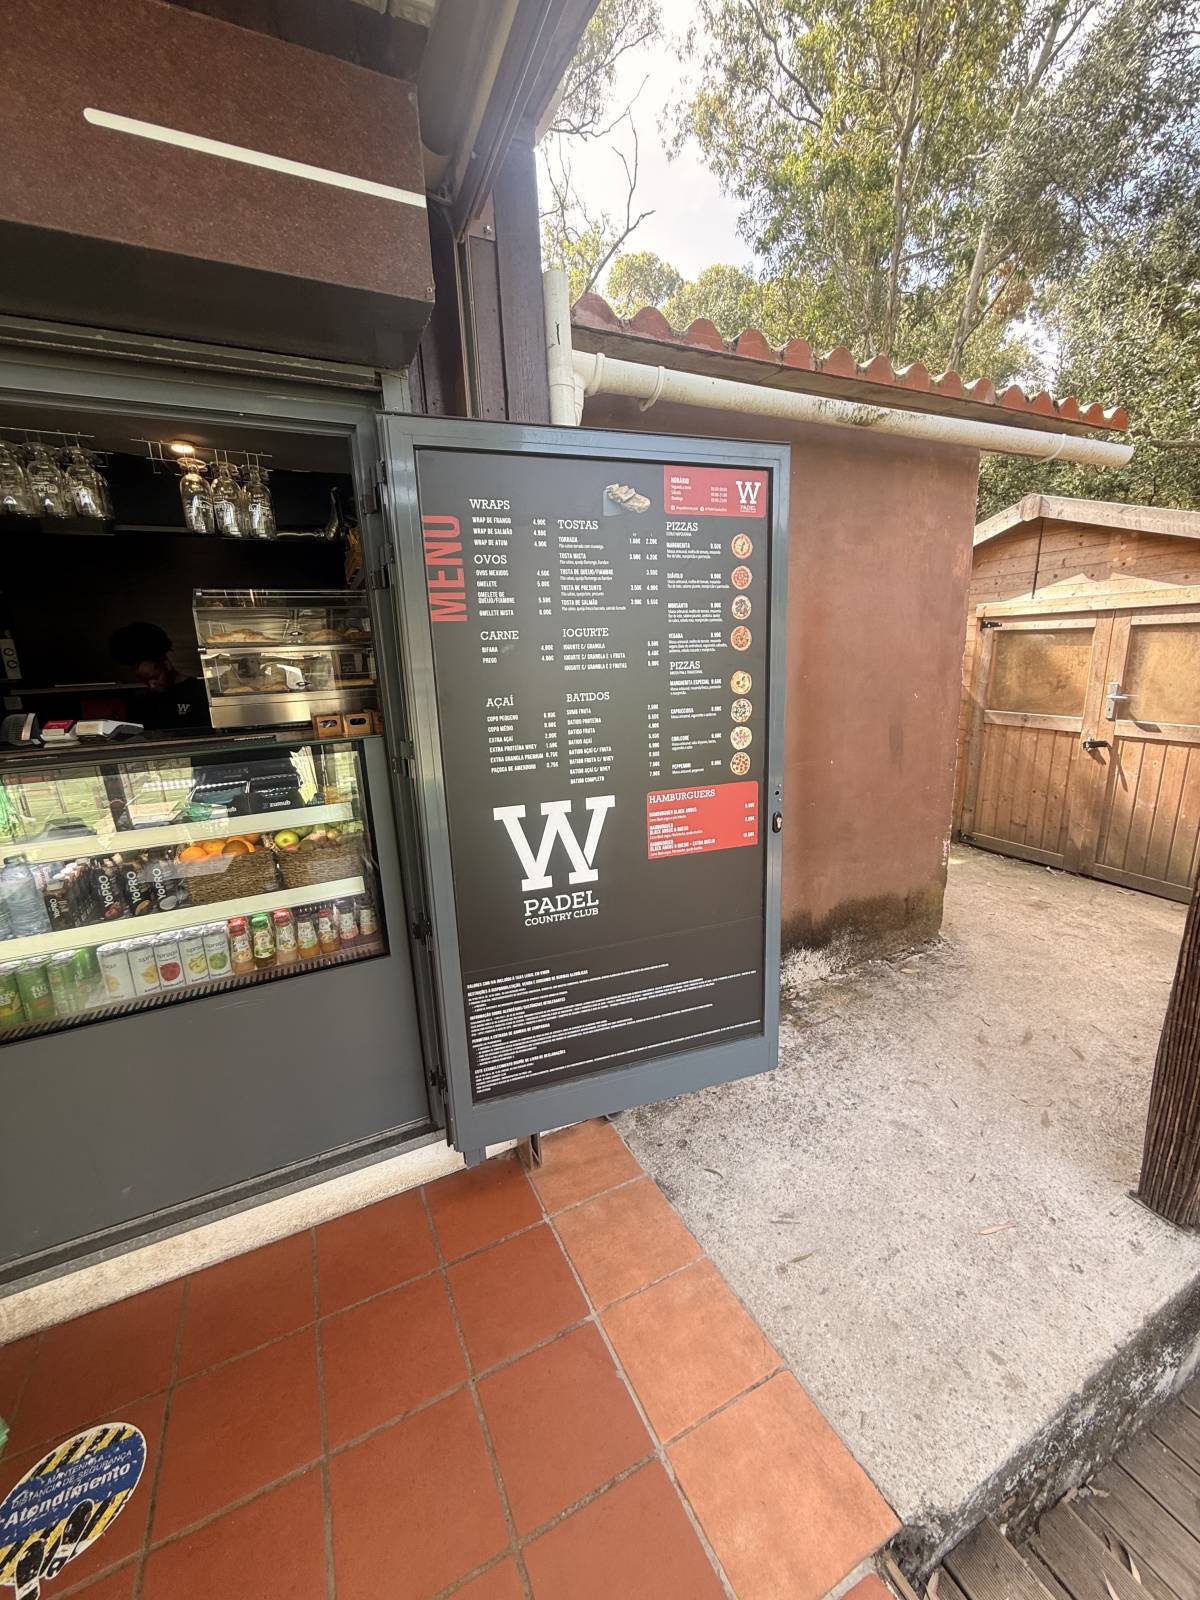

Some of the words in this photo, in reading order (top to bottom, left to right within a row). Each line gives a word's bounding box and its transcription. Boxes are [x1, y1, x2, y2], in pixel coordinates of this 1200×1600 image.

[736, 481, 761, 504] W
[469, 499, 510, 510] WRAPS
[558, 520, 598, 530] TOSTAS
[666, 522, 698, 531] PIZZAS
[474, 555, 507, 564] OVOS
[422, 515, 468, 621] MENU
[480, 631, 519, 640] CARNE
[563, 628, 608, 637] IOGURTE
[670, 661, 700, 670] PIZZAS
[486, 694, 514, 709] AÇAÍ
[567, 692, 610, 702] BATIDOS
[649, 789, 715, 804] HAMBURGUERS
[493, 795, 615, 891] W
[98, 875, 113, 907] YoPRO
[127, 871, 140, 903] YoPRO
[152, 868, 165, 900] YoPRO
[524, 890, 599, 916] PADEL
[525, 912, 572, 926] COUNTRY
[574, 908, 598, 918] CLUB
[4, 1462, 131, 1529] Atendimento
